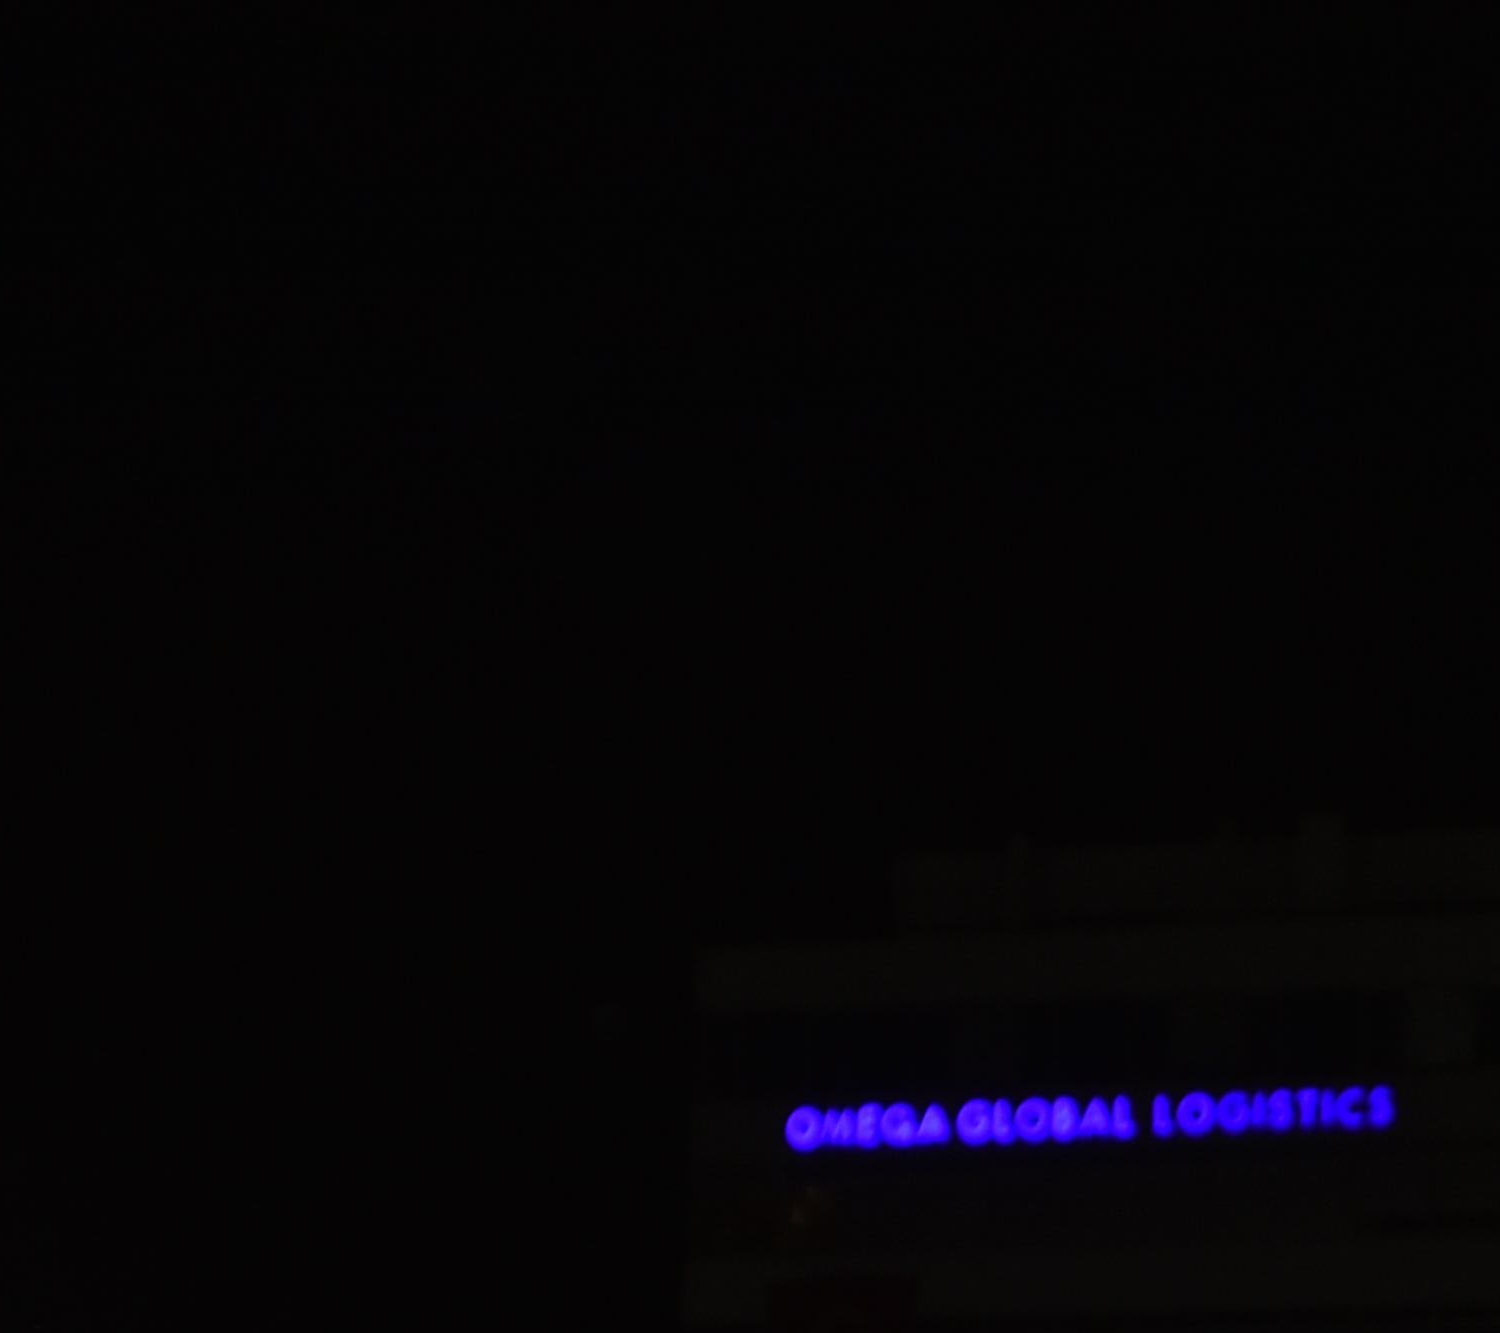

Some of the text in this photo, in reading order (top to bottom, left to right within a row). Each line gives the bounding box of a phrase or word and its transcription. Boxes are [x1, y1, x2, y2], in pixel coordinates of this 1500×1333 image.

[785, 1085, 1394, 1151] OMEGA GLOBAL LOGISTICS
